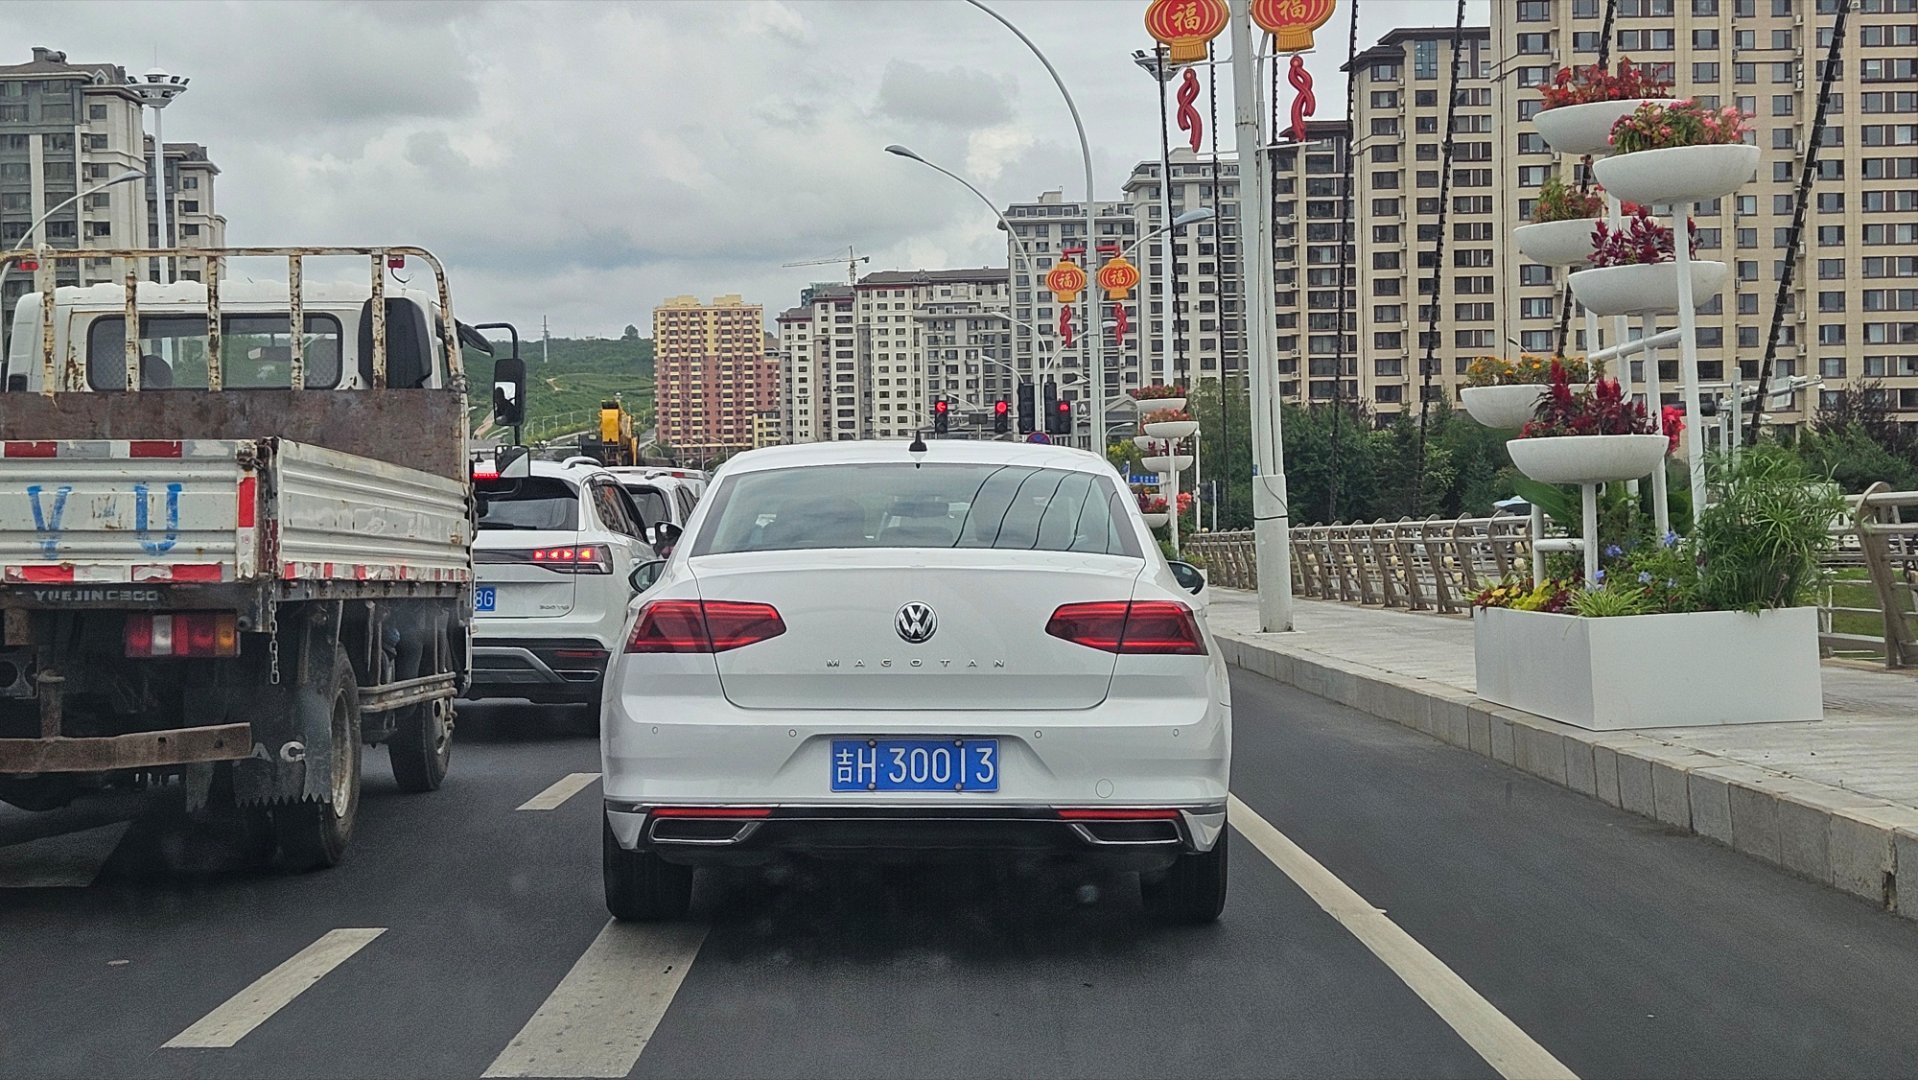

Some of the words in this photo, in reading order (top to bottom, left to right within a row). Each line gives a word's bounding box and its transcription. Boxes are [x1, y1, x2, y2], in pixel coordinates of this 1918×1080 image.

[1171, 4, 1200, 32] 福
[1276, 0, 1306, 20] 福
[826, 658, 1004, 668] MAGOTAN
